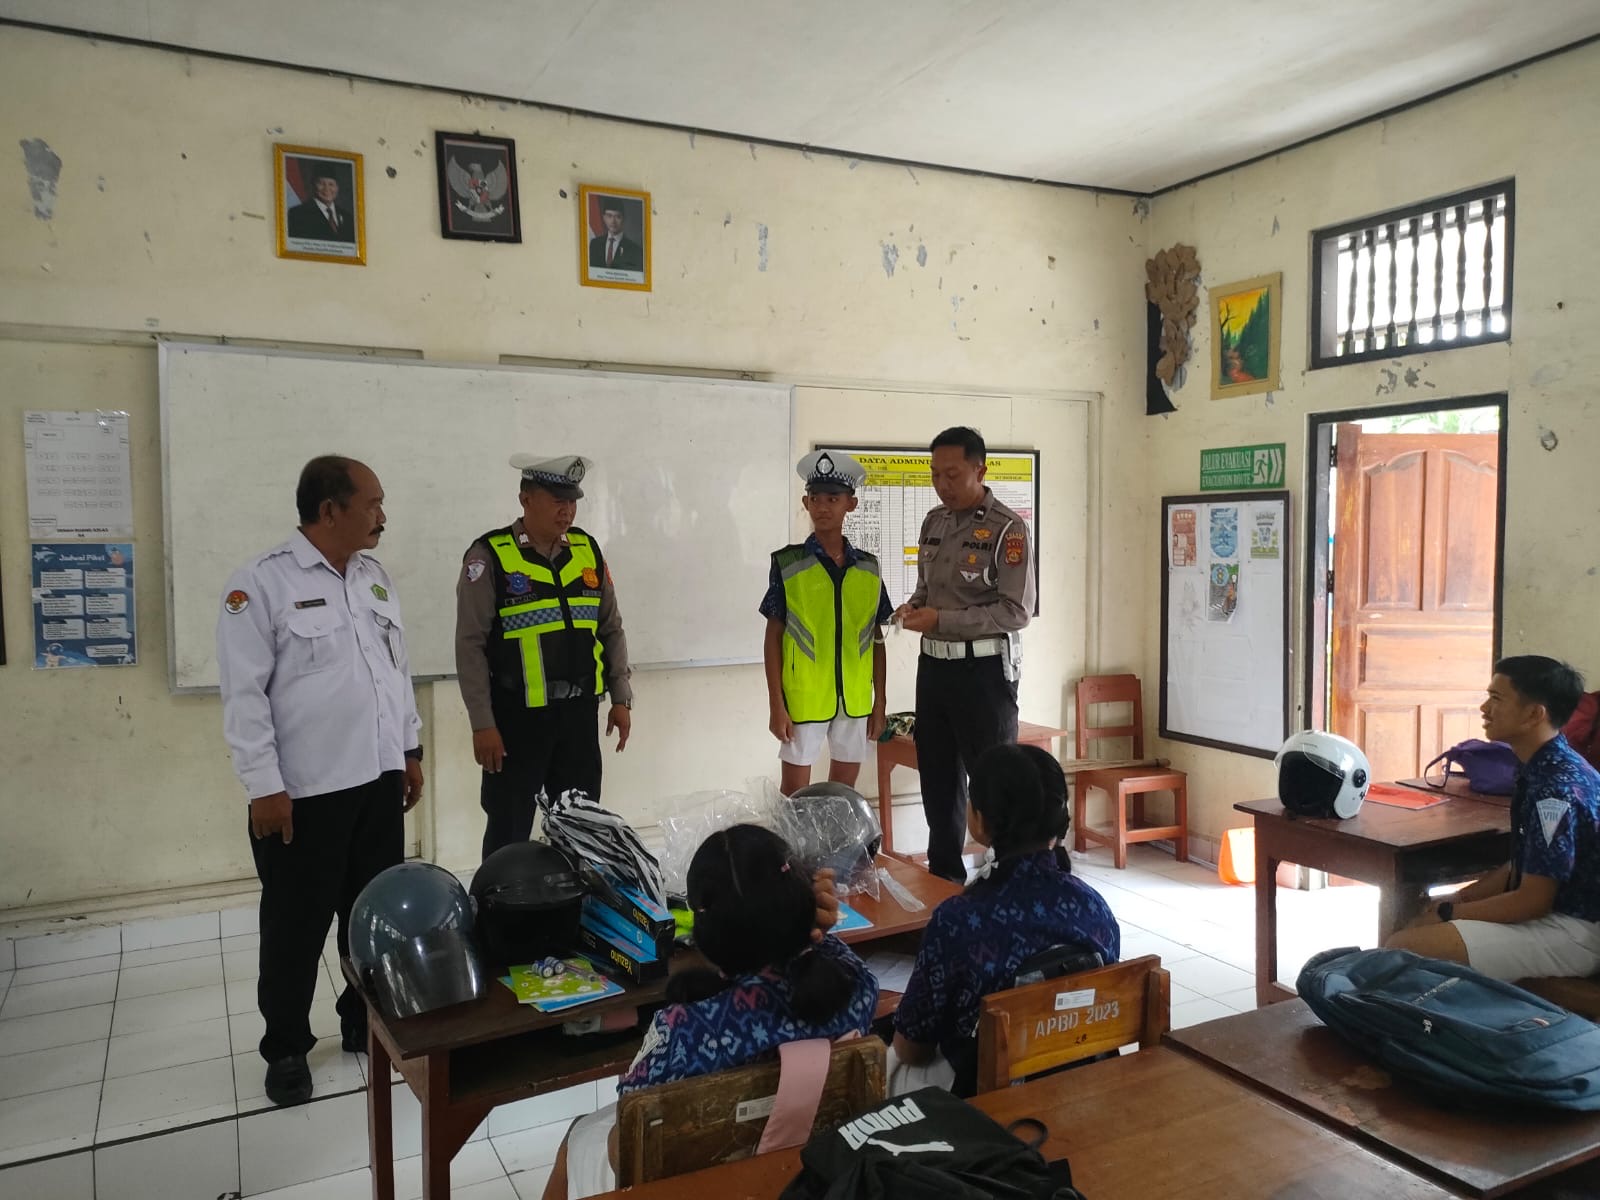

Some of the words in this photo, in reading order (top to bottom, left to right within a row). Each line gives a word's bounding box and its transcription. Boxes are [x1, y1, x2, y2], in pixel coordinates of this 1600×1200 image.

[59, 554, 86, 562] Jadwal
[962, 541, 992, 551] POLRI
[1035, 1011, 1079, 1040] APBD
[1085, 1000, 1119, 1024] 2023
[838, 1097, 926, 1150] PUMA
